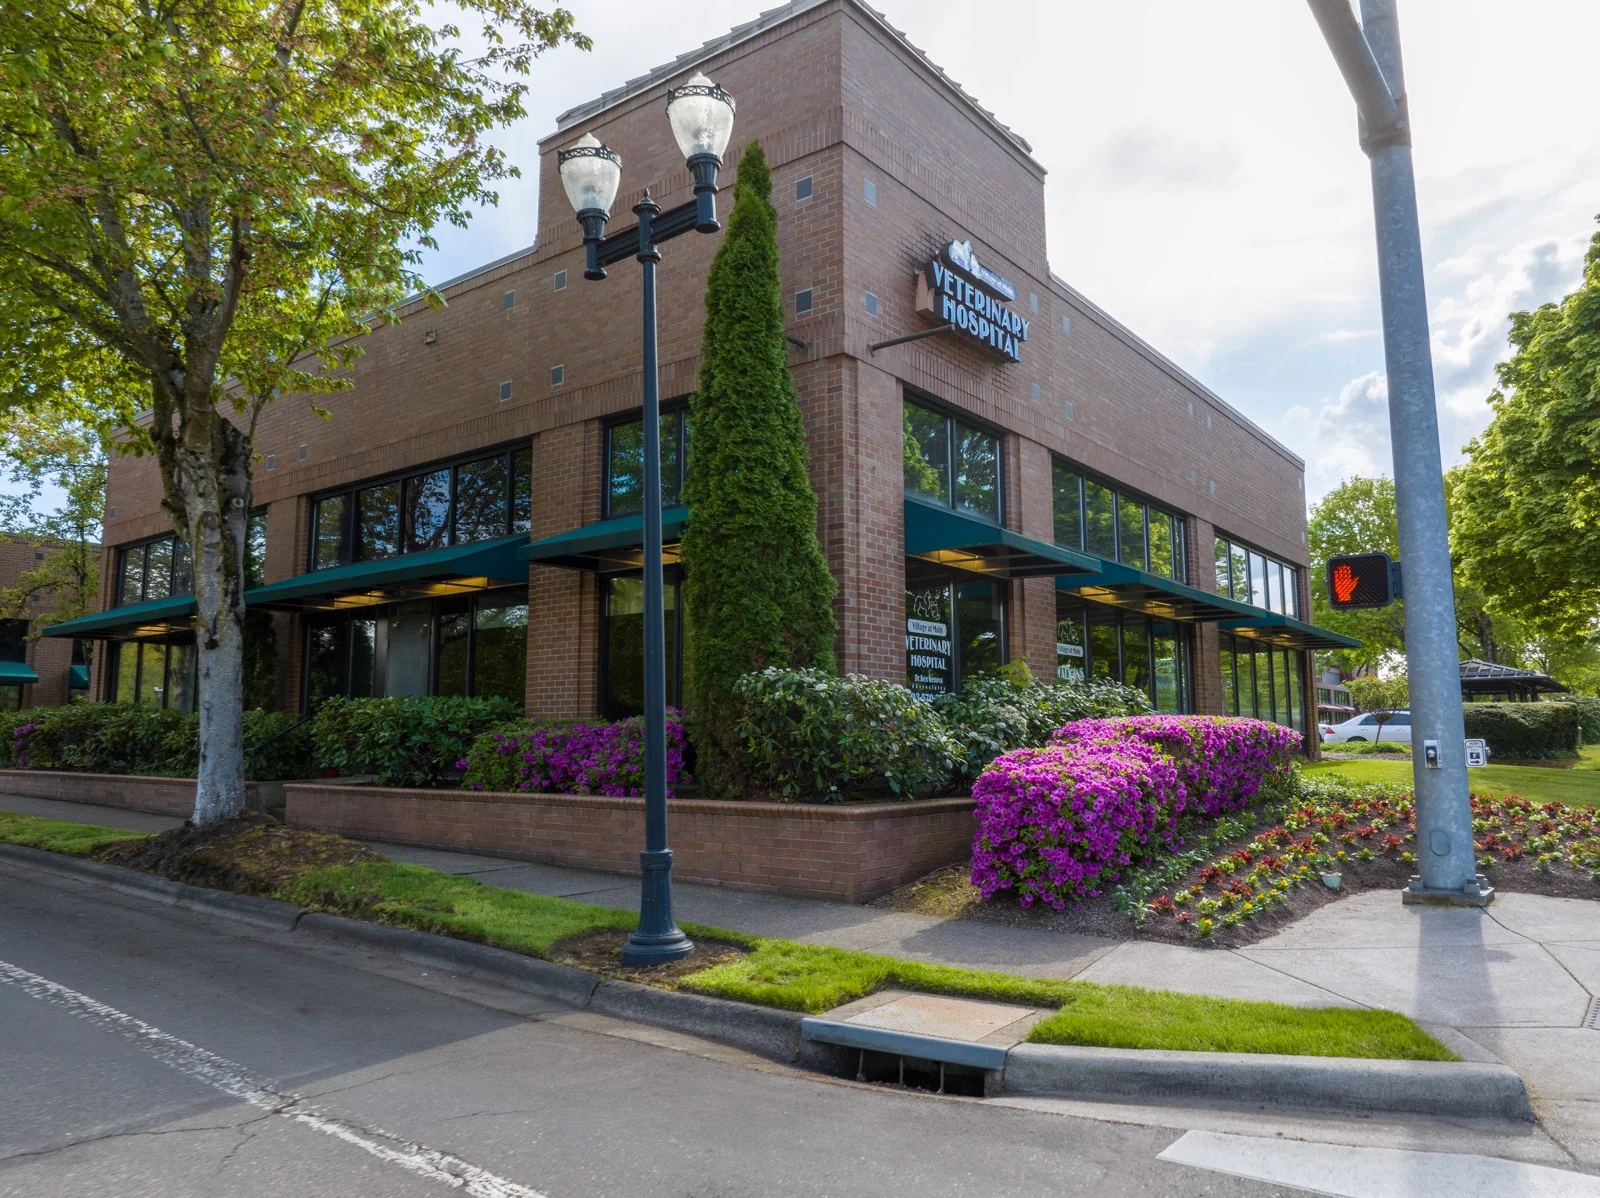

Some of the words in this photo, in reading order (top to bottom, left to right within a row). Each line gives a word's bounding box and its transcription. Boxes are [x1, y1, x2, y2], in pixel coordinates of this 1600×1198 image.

[933, 260, 1030, 341] VETERINARY
[943, 294, 1022, 362] HOSPITAL
[912, 621, 927, 633] Village
[933, 624, 943, 634] Main
[905, 635, 952, 656] VETERINARY
[911, 654, 947, 669] HOSPITAL
